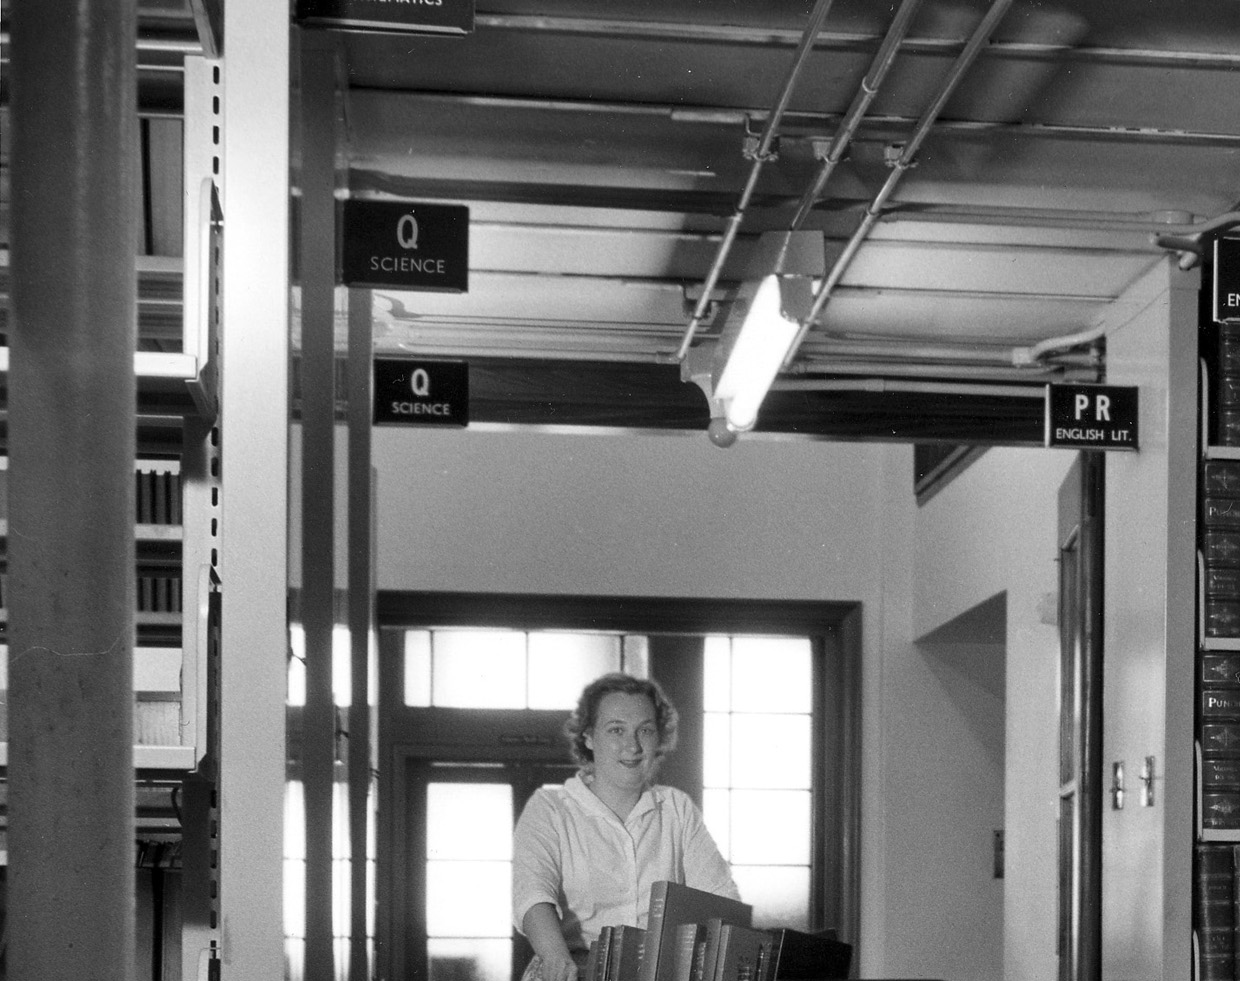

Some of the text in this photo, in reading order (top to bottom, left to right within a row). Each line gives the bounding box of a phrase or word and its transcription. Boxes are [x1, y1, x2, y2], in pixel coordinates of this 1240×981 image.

[397, 214, 418, 249] Q
[370, 256, 445, 273] SCIENCE
[411, 369, 429, 396] Q
[392, 402, 450, 415] SCIENCE
[1056, 428, 1132, 441] ENGLISH LIT.
